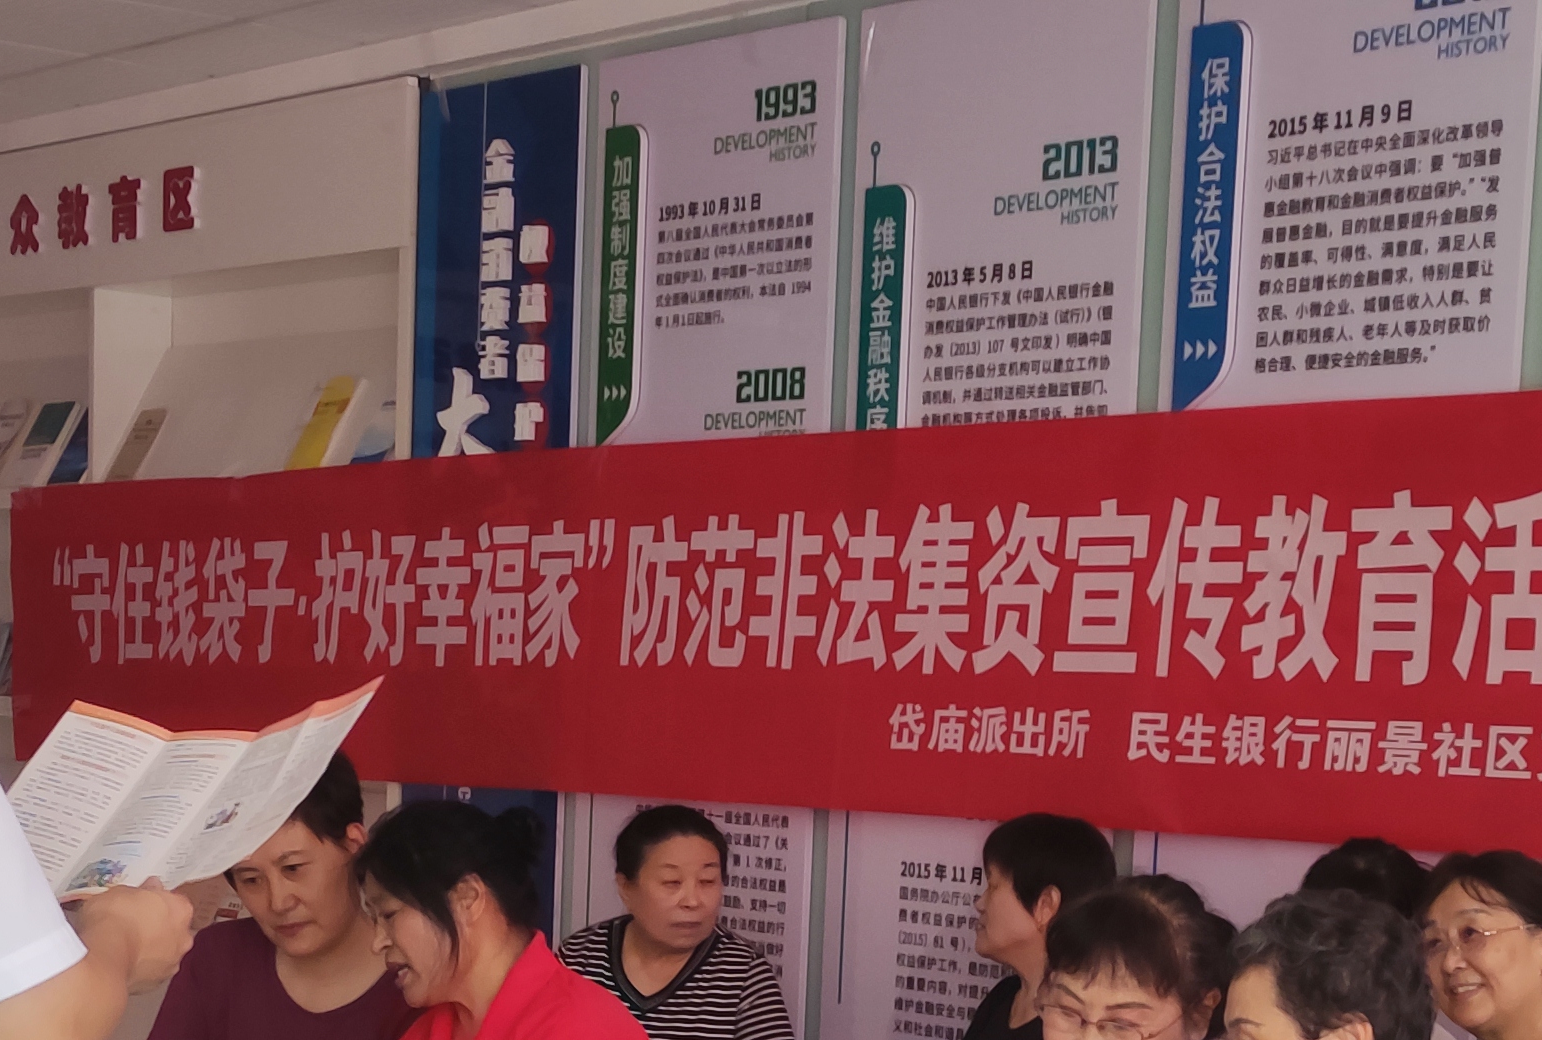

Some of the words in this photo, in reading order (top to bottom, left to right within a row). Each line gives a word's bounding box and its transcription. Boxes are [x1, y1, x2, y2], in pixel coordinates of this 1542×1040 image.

[1354, 7, 1511, 54] DEVELOPMENT
[1437, 33, 1510, 60] HISTORY
[755, 80, 817, 122] 1993
[714, 122, 817, 155] DEVELOPMENT
[769, 144, 817, 163] HISTORY
[1042, 135, 1119, 181] 2013
[994, 181, 1119, 216] DEVELOPMENT
[1189, 57, 1230, 310] 保护合法权益
[1060, 205, 1119, 225] HISTORY
[607, 155, 633, 359] 加强制度建设
[865, 216, 897, 430] 维护金融秩序
[736, 366, 806, 403] 2008
[704, 408, 806, 431] DEVELOPMENT
[888, 702, 1091, 760] 岱庙派出所
